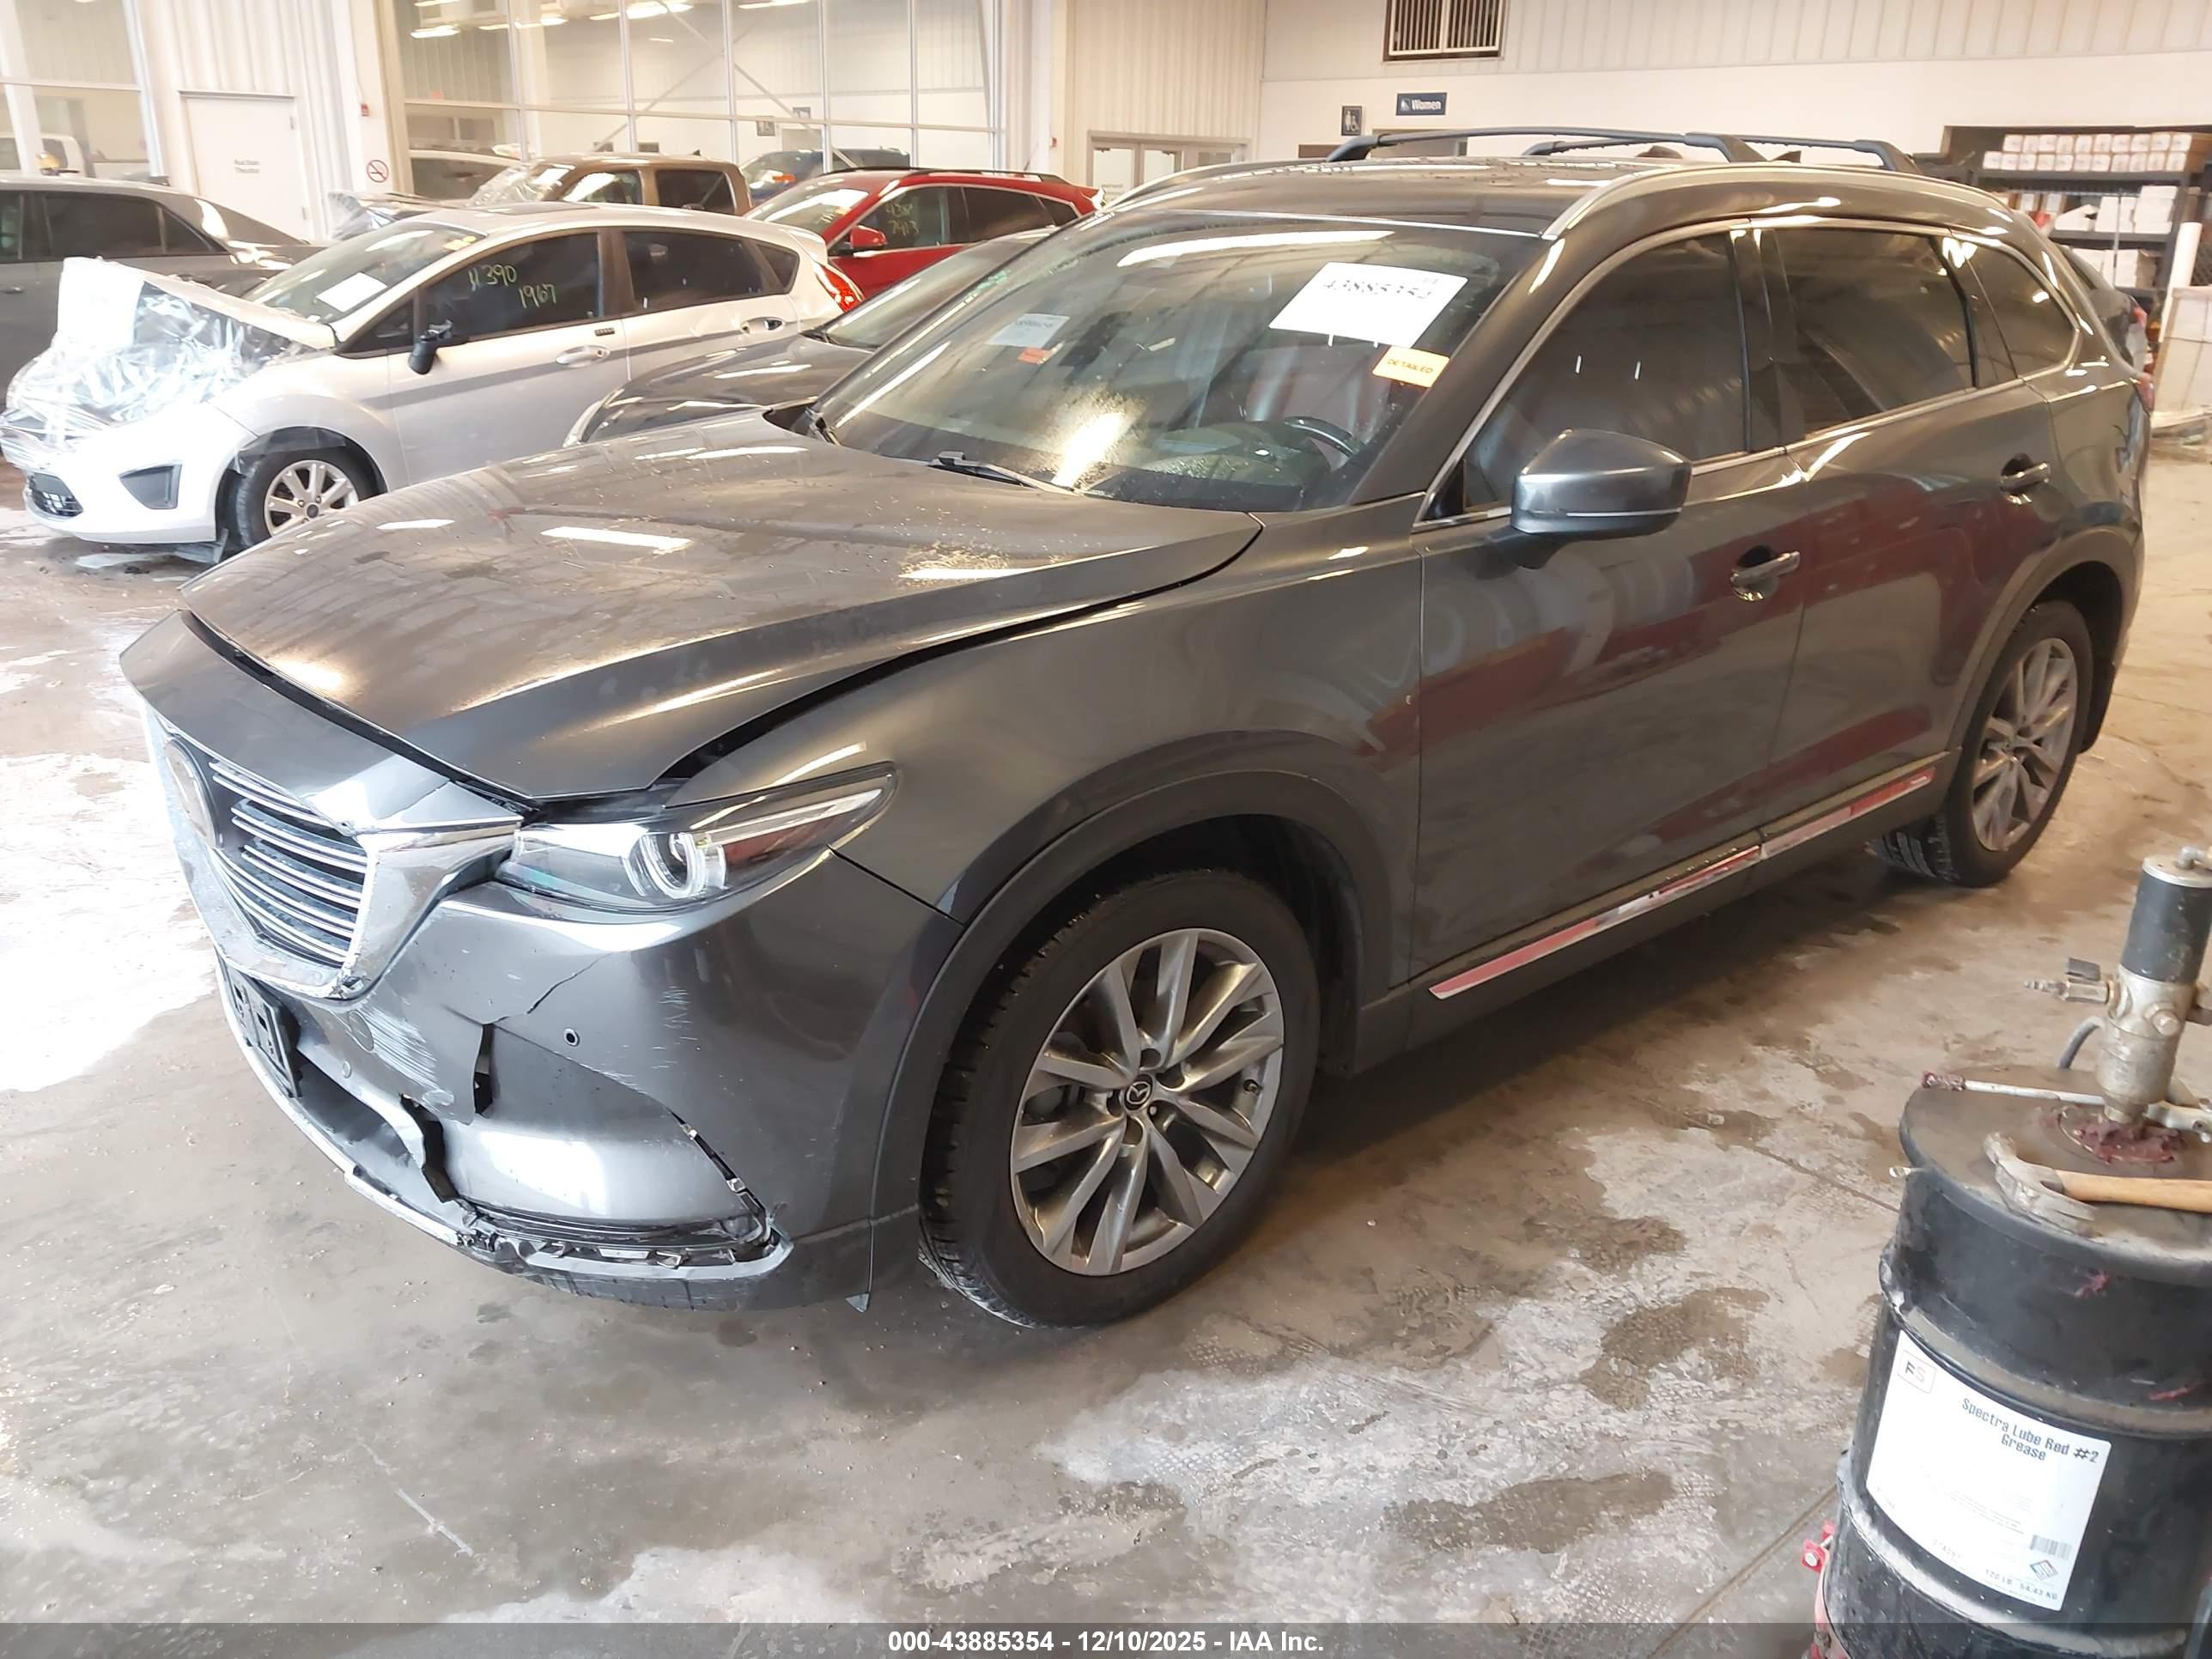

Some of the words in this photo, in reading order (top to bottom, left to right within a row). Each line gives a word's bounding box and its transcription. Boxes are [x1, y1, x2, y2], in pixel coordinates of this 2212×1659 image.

[1411, 99, 1442, 111] Women
[519, 283, 557, 309] 1967
[1905, 1359, 1926, 1383] FS
[1961, 1397, 2009, 1433] Spectra
[2012, 1424, 2042, 1446] Lube
[2045, 1437, 2070, 1455] Red
[2072, 1446, 2100, 1464] #2
[2001, 1433, 2047, 1462] Grease
